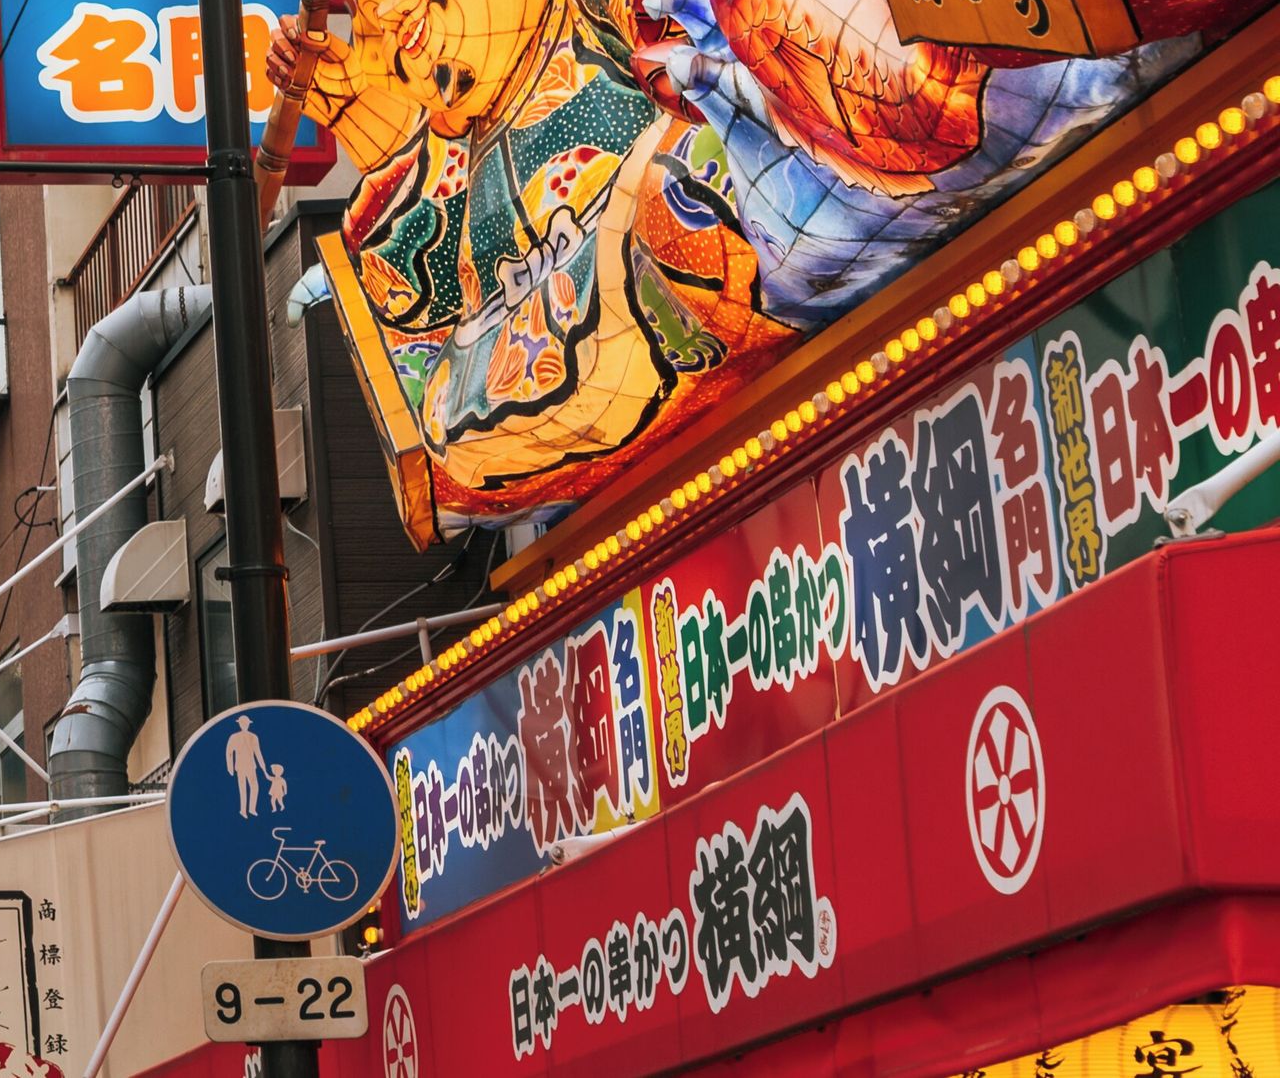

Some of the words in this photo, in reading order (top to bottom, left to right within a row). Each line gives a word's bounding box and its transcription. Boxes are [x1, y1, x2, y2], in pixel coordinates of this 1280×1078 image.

[50, 12, 276, 114] 名門
[845, 402, 1004, 676] 横綱
[992, 373, 1045, 606] 名門
[612, 617, 652, 802] 名門
[654, 587, 687, 777] 新世界
[683, 554, 846, 728] 日本一の串かつ
[414, 739, 520, 872] 日本一の串かつ
[524, 632, 614, 844] 横綱
[37, 899, 68, 1055] 商標登録
[512, 917, 685, 1054] 日本一の串かつ
[695, 807, 816, 991] 横綱
[215, 976, 357, 1024] 9-22
